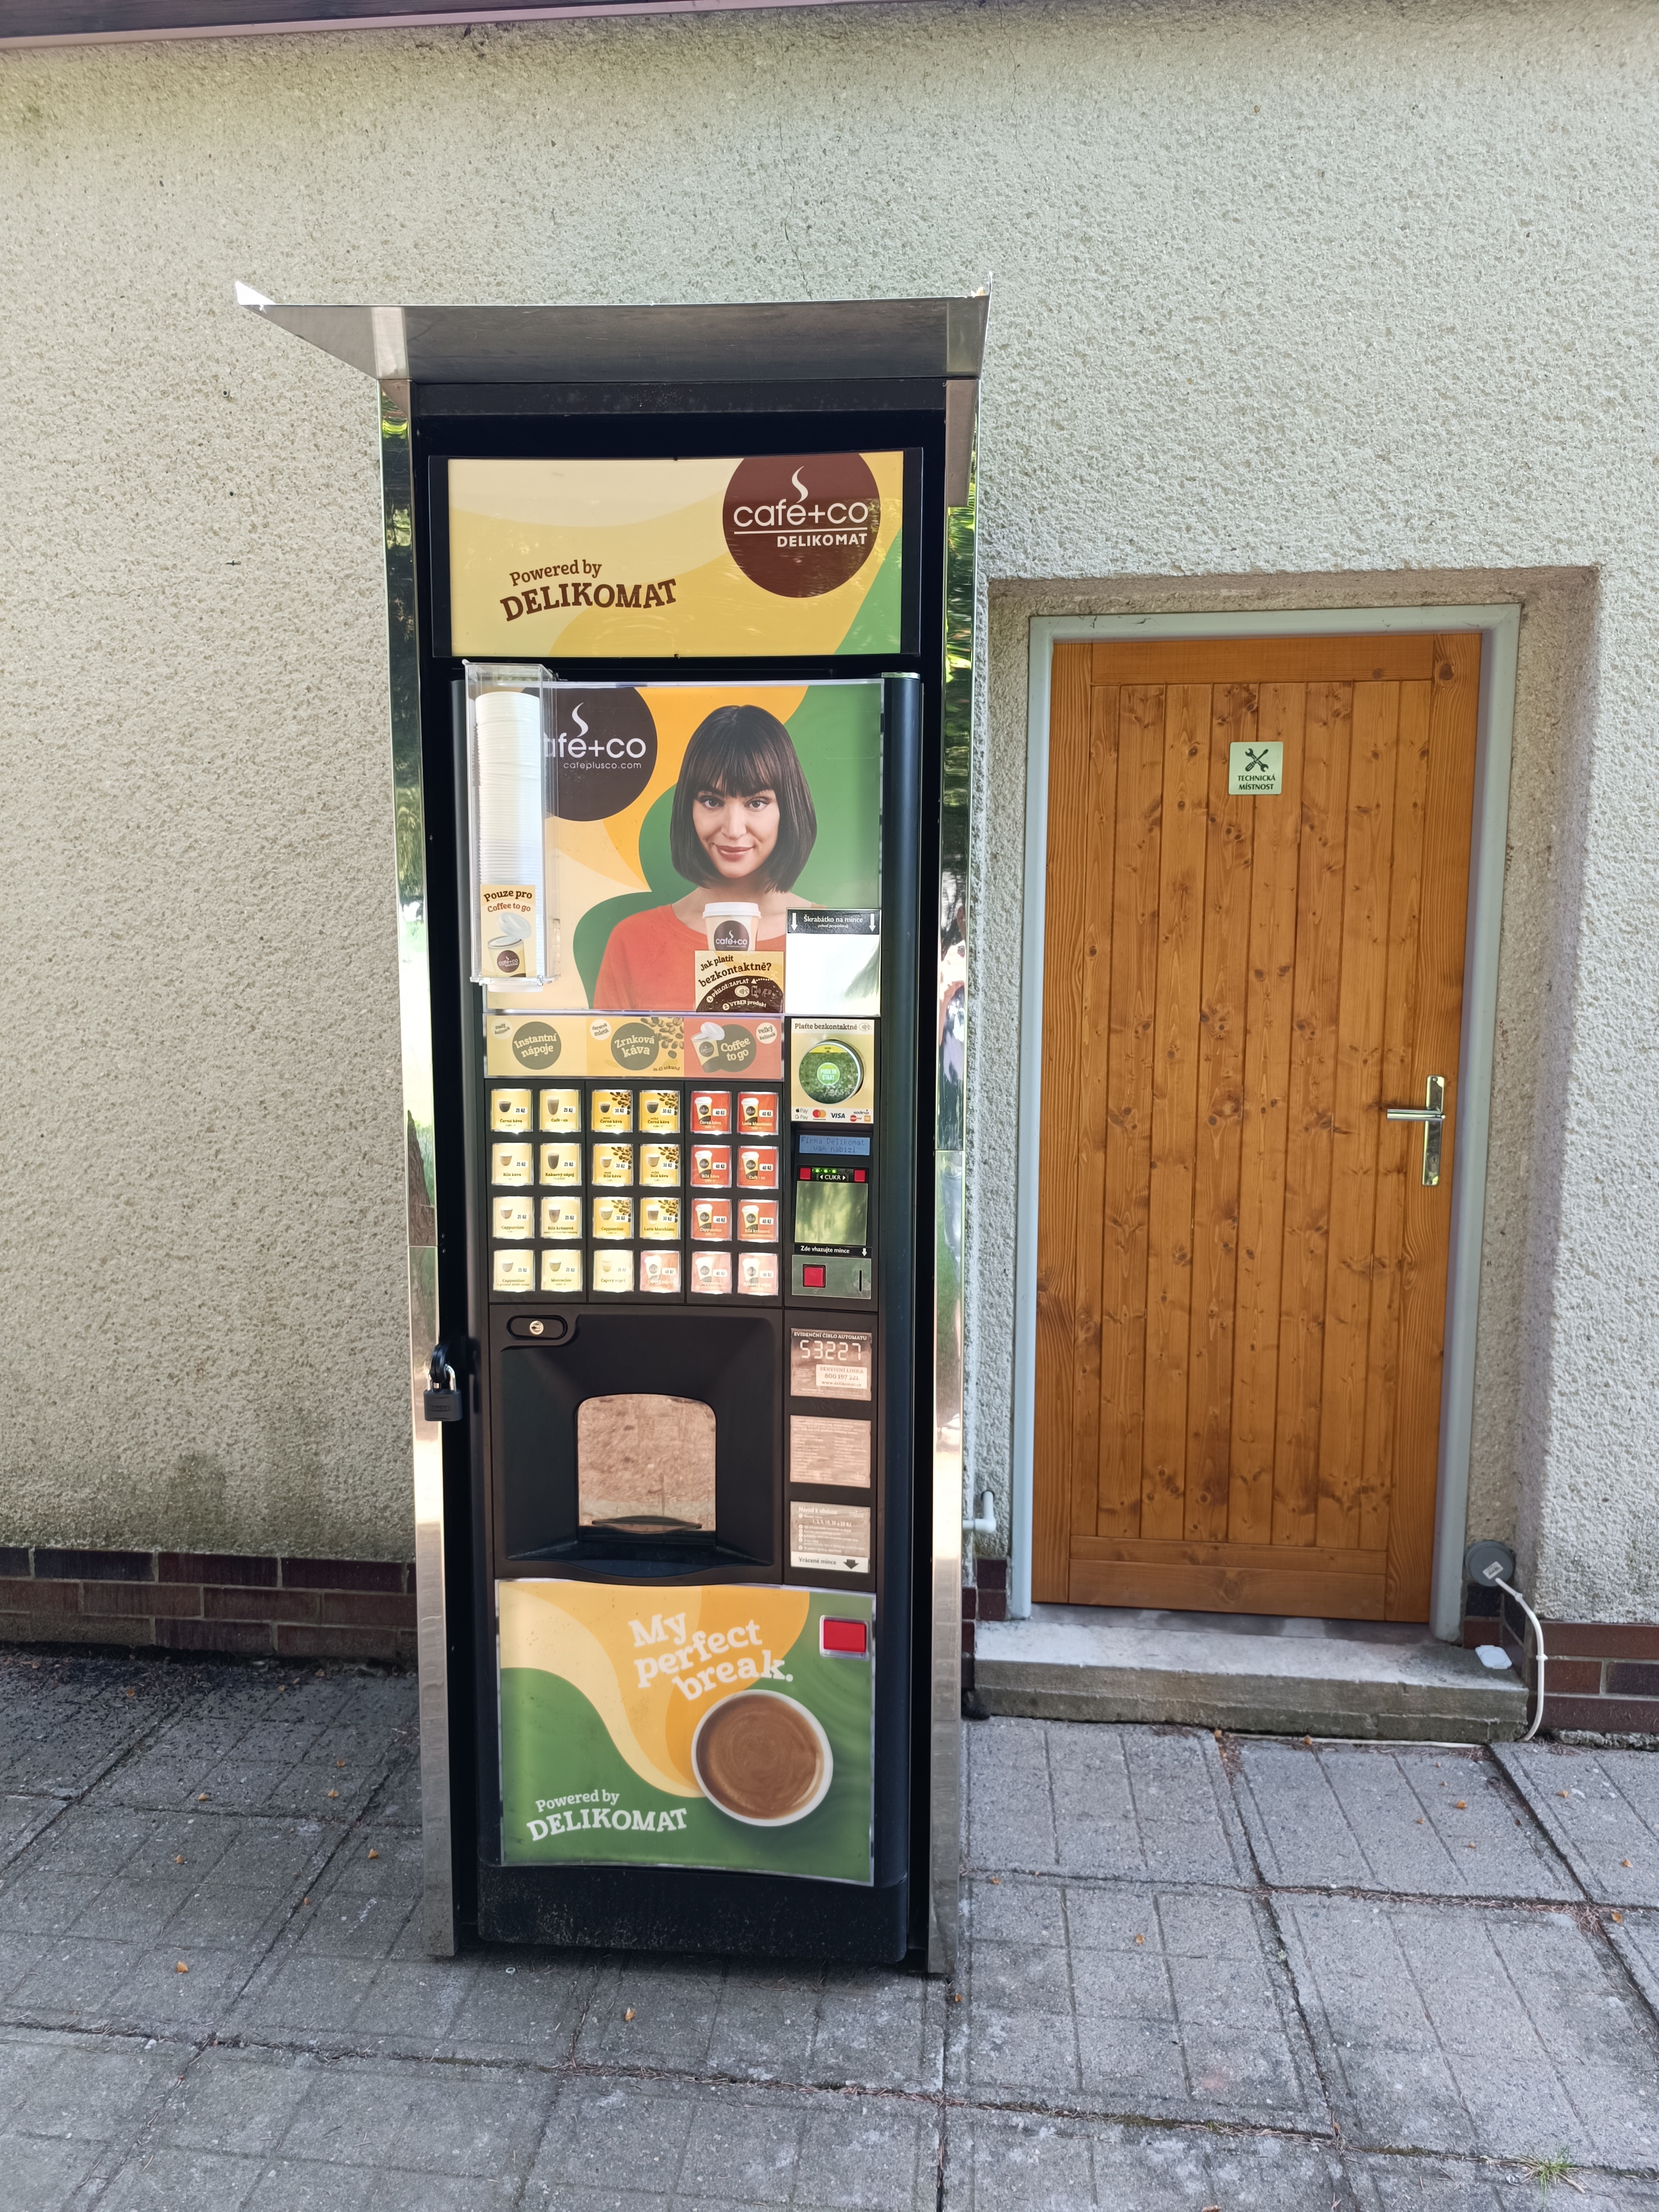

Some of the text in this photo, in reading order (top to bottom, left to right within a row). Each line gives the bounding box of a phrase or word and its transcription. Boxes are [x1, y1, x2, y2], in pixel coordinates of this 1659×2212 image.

[777, 533, 867, 547] DELIKOMAT
[510, 559, 602, 586] Powered by
[500, 578, 676, 622] DELIKOMAT
[563, 762, 641, 770] cafeplusco.com
[484, 890, 532, 902] Pouze pro
[487, 903, 511, 912] Coffee
[700, 955, 734, 971] Jak platit
[698, 962, 771, 987] bezkontaktně?
[594, 1028, 609, 1036] mletá
[758, 1025, 773, 1033] velký
[514, 1033, 557, 1049] Instantní
[614, 1035, 654, 1048] Zrnková
[721, 1038, 750, 1052] Coffee
[521, 1044, 554, 1057] nápoje
[621, 1045, 650, 1057] káva
[737, 1049, 749, 1061] go
[800, 1340, 861, 1360] 53227
[628, 1612, 686, 1648] My
[634, 1619, 762, 1688] perfect
[671, 1649, 794, 1701] break.
[536, 1789, 620, 1812] Powered by
[526, 1808, 687, 1841] DELIKOMAT
